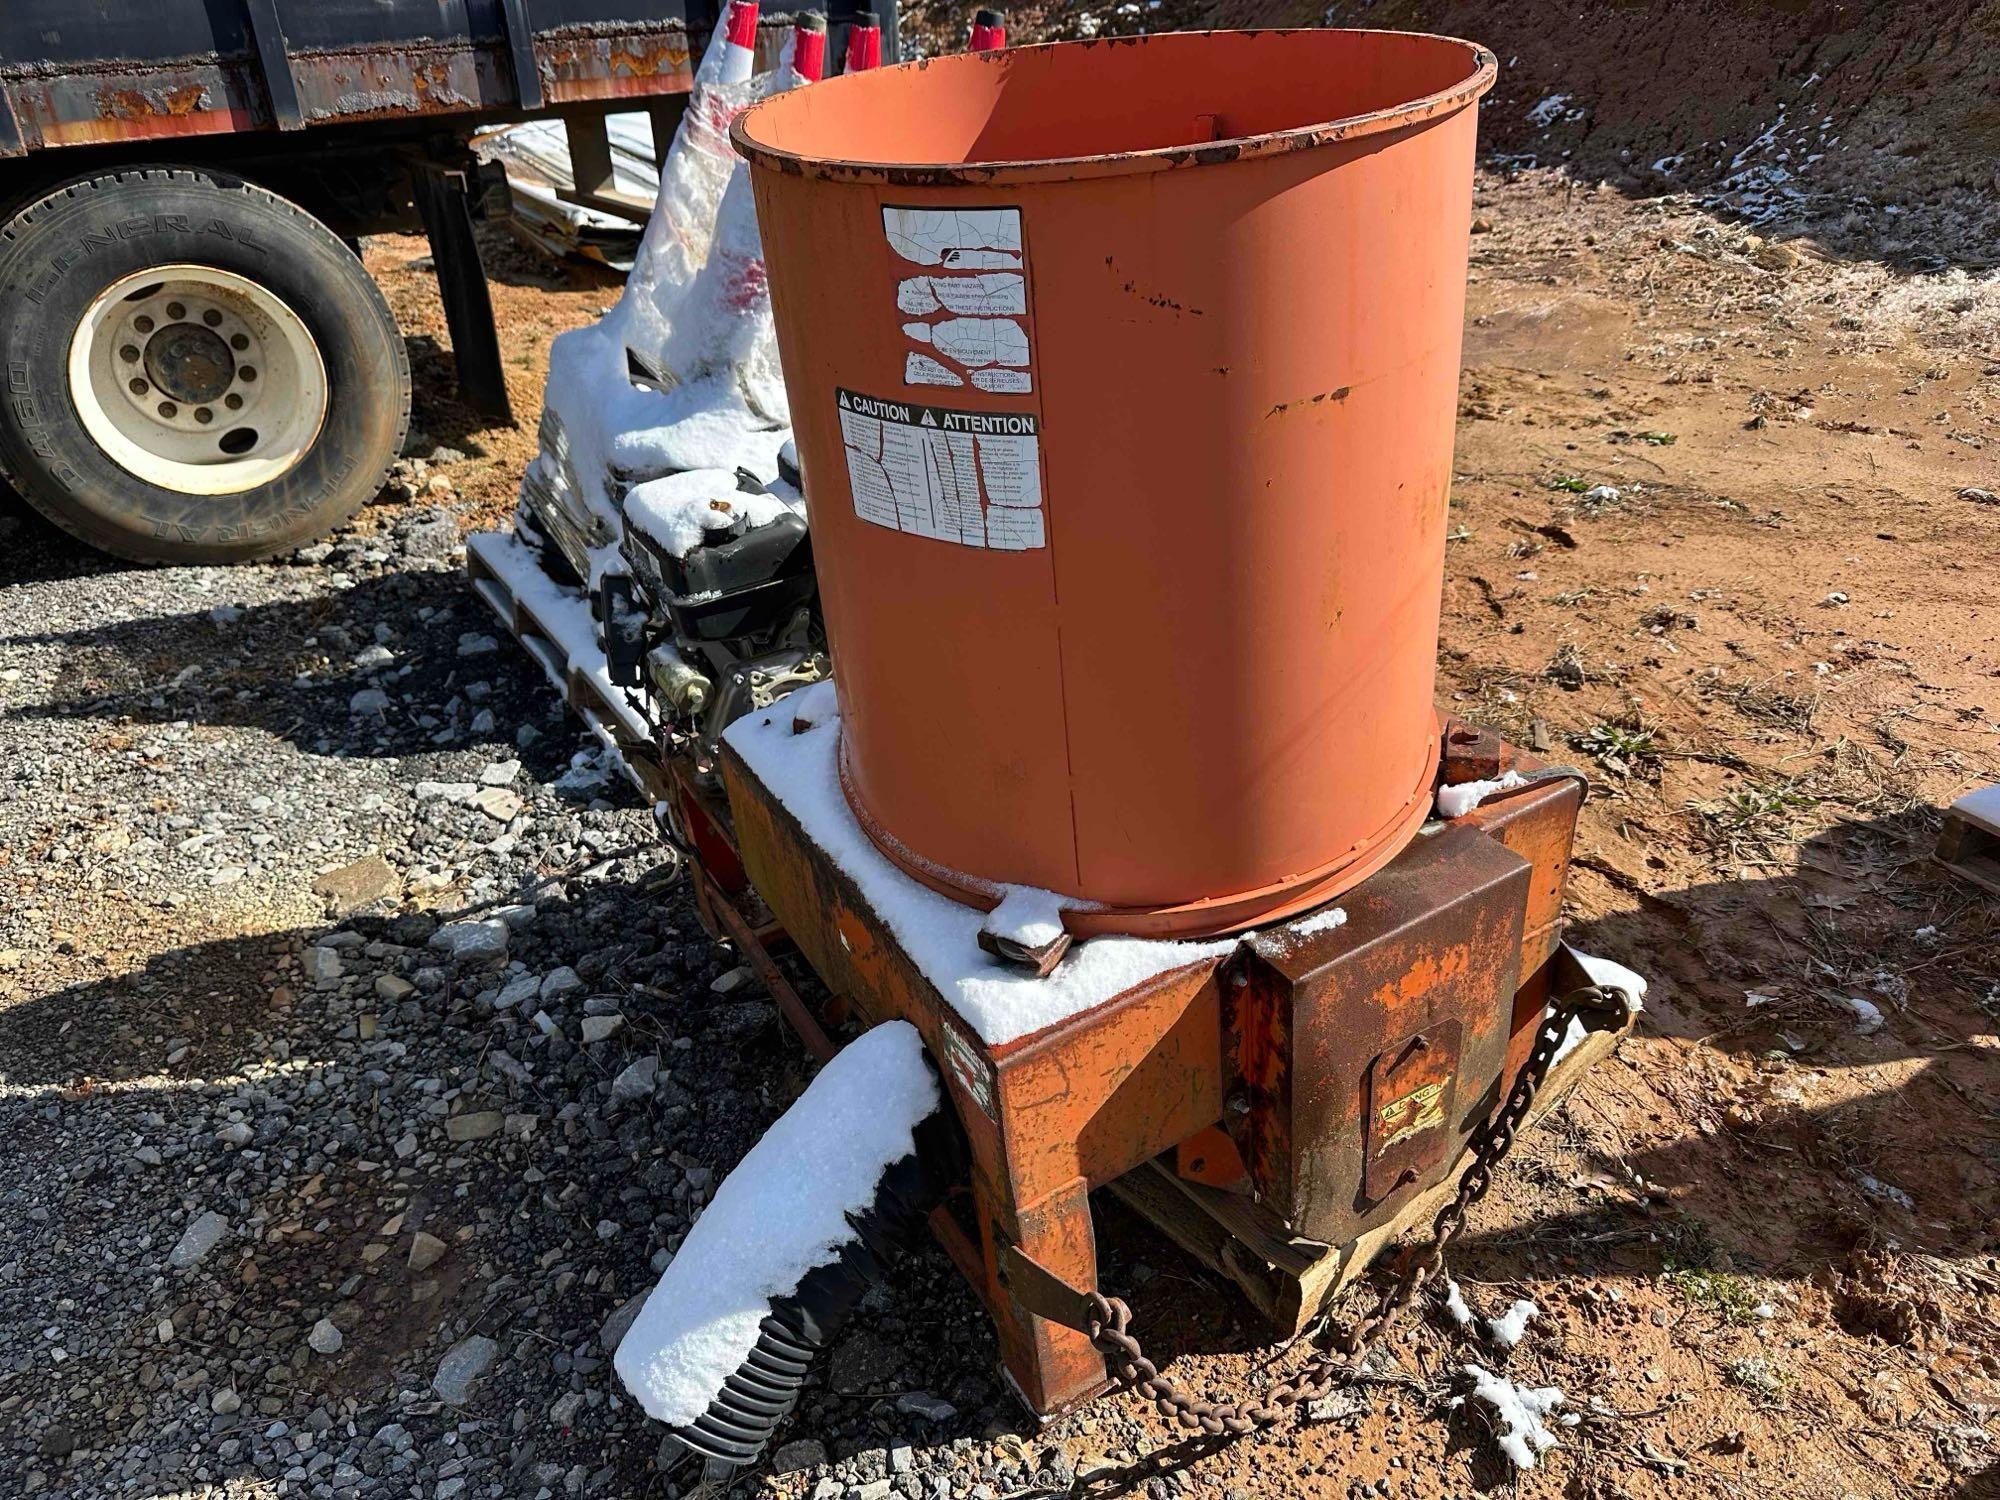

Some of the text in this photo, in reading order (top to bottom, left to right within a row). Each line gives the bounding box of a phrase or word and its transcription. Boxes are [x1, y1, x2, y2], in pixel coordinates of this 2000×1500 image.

[26, 213, 268, 304] GENERAL
[7, 360, 85, 492] D460
[853, 396, 1035, 433] CAUTION ATTENTION
[1398, 1082, 1442, 1110] DNGER
